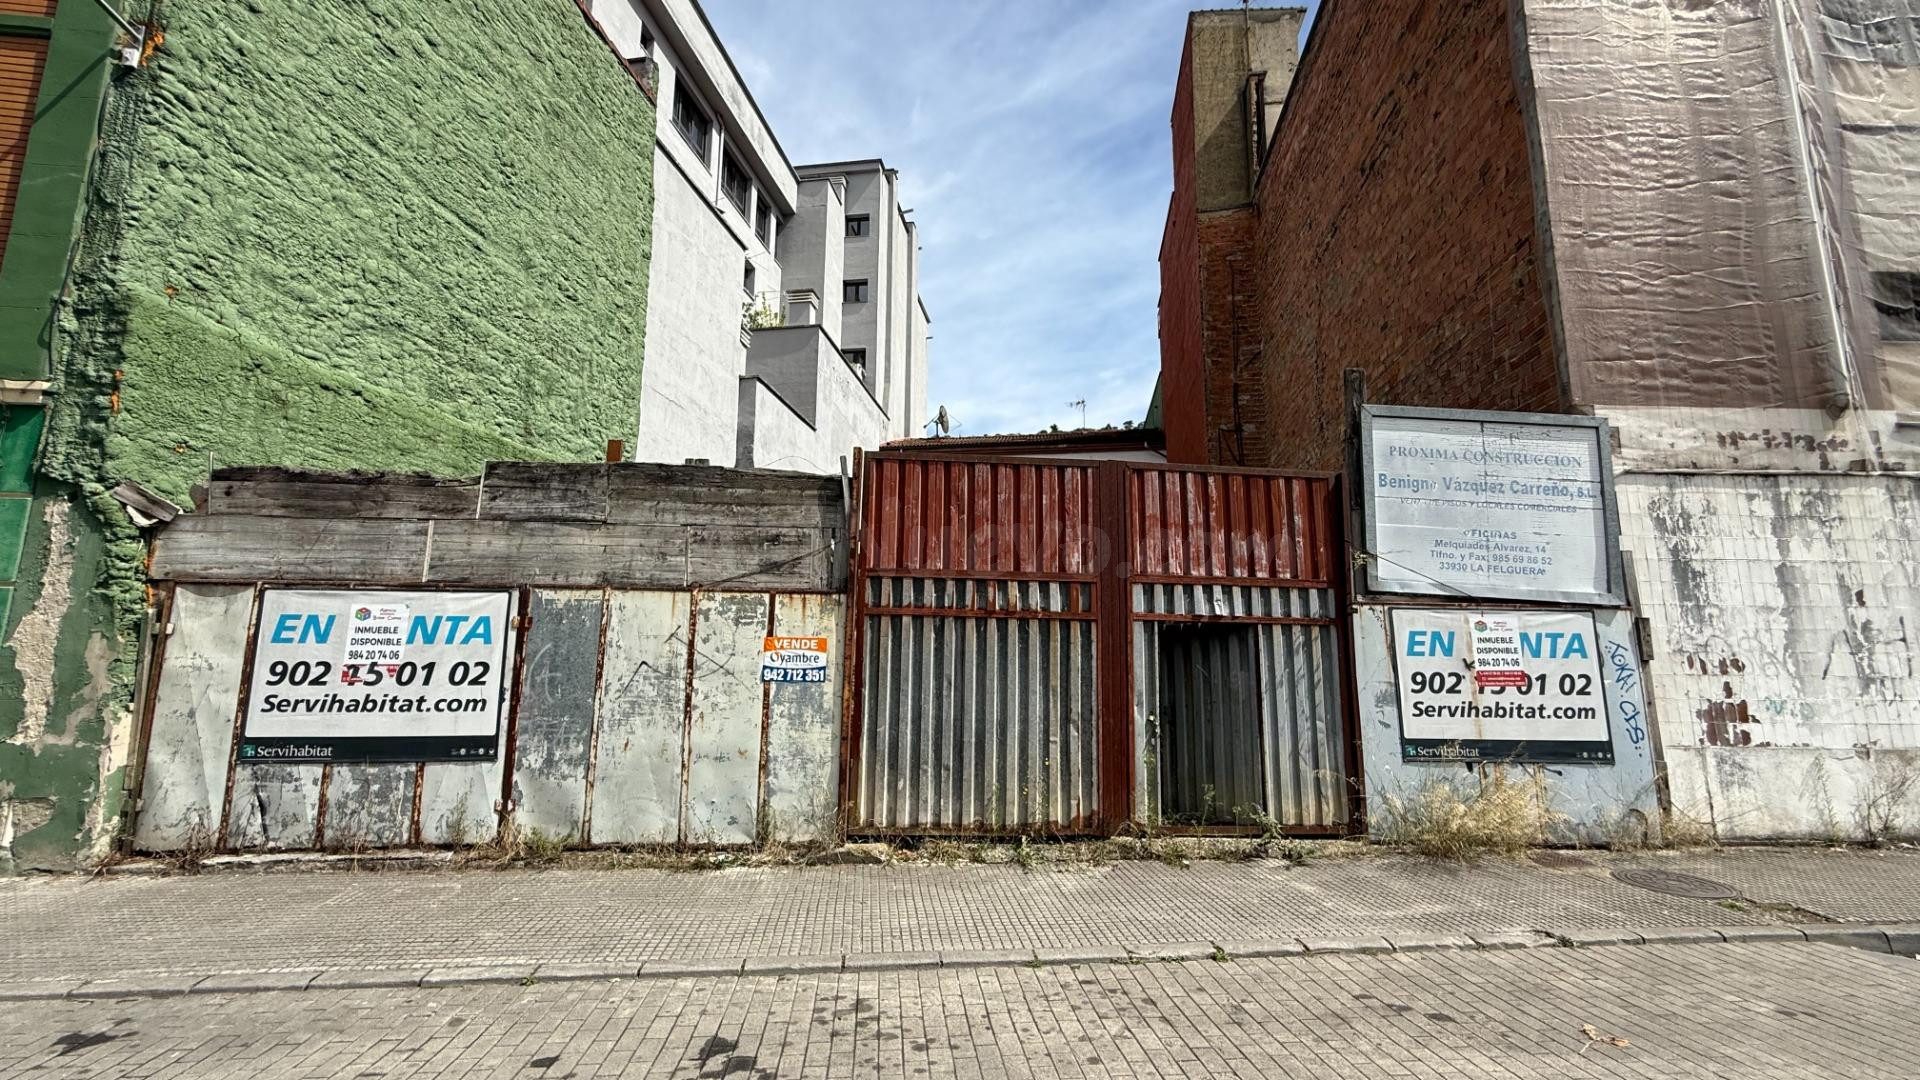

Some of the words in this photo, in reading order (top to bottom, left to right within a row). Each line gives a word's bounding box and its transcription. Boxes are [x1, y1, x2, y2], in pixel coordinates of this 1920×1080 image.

[1389, 446, 1458, 460] PROXIMA
[1463, 450, 1582, 468] CONSTRUCCION
[1442, 476, 1505, 495] Vázquez
[1510, 480, 1574, 500] Carreño,
[1577, 487, 1597, 498] S.L.
[1434, 540, 1490, 550] Melquiades
[1536, 546, 1546, 554] 14
[1460, 554, 1466, 562] y
[1492, 554, 1510, 562] 985
[1512, 555, 1524, 564] 69
[1542, 557, 1552, 566] 52
[1439, 562, 1468, 572] 33930
[1471, 564, 1484, 572] LA
[1487, 564, 1544, 576] FELGUERA
[270, 614, 336, 644] EN
[406, 615, 492, 646] NTA
[354, 626, 398, 634] INMUEBLE
[774, 639, 818, 649] VENDE
[1406, 630, 1456, 657] EN
[1520, 632, 1588, 659] NTA
[348, 650, 363, 660] 984
[365, 650, 376, 660] 20
[377, 650, 388, 660] 74
[389, 650, 400, 660] 06
[770, 652, 820, 665] Oyambre
[1478, 658, 1490, 667] 984
[1492, 658, 1500, 667] 20
[1502, 658, 1510, 667] 74
[1511, 658, 1520, 667] 06
[266, 660, 332, 687] 902
[395, 661, 436, 687] 01
[448, 661, 490, 686] 02
[764, 669, 784, 681] 942
[786, 670, 803, 681] 712
[805, 670, 824, 681] 351
[1410, 672, 1462, 694] 902
[1558, 673, 1592, 696] 02
[260, 694, 486, 714] Servihabitat.com
[1412, 702, 1596, 720] Servihabitat.com
[257, 745, 332, 758] Servihabitat
[1418, 746, 1479, 758] Servihabitat
